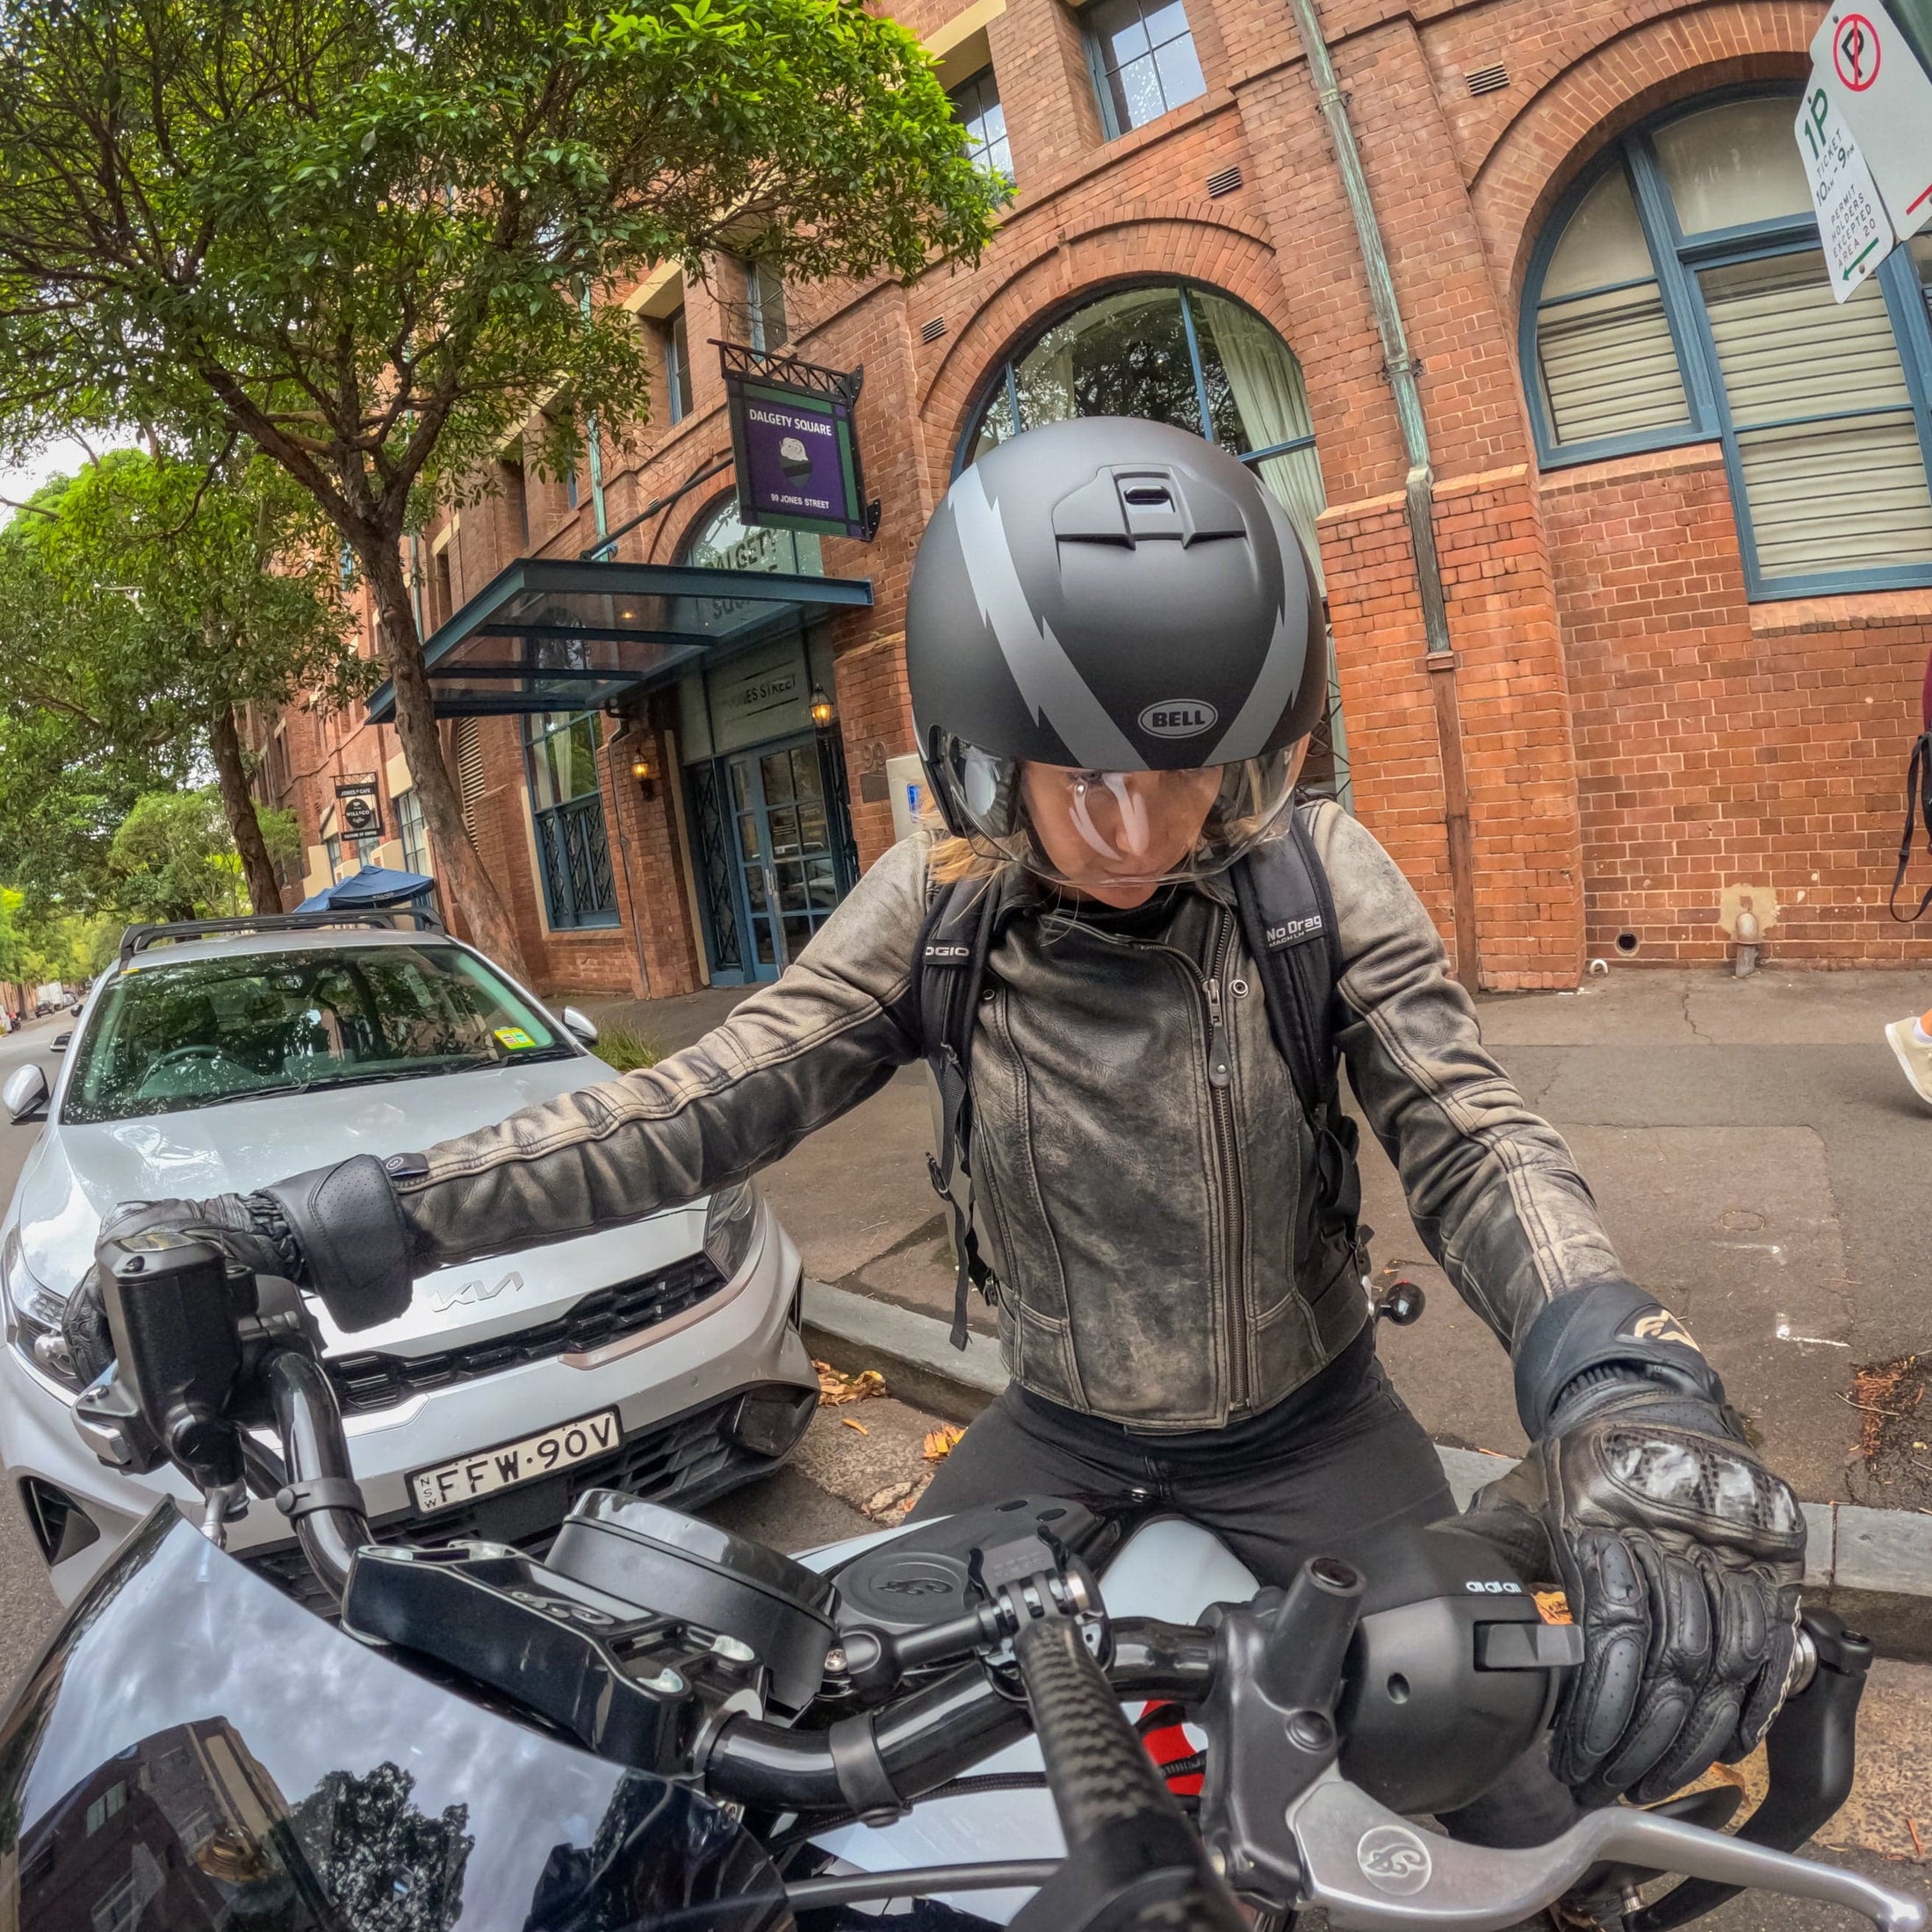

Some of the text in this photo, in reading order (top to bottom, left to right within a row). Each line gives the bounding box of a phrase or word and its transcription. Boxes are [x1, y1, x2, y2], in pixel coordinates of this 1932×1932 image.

[1805, 88, 1828, 162] 1P
[1816, 127, 1842, 179] TICKET
[1830, 183, 1856, 226] PERMIT
[1831, 191, 1864, 242] HOLDERS
[1833, 203, 1871, 258] EXCEPTED
[1838, 218, 1876, 270] AREA 20
[749, 408, 833, 436] DALGETY SQUARE
[770, 493, 830, 509] 99 JONES STREET
[1151, 709, 1207, 728] BELL
[1265, 915, 1323, 942] No Drag
[420, 1476, 436, 1509] NSW
